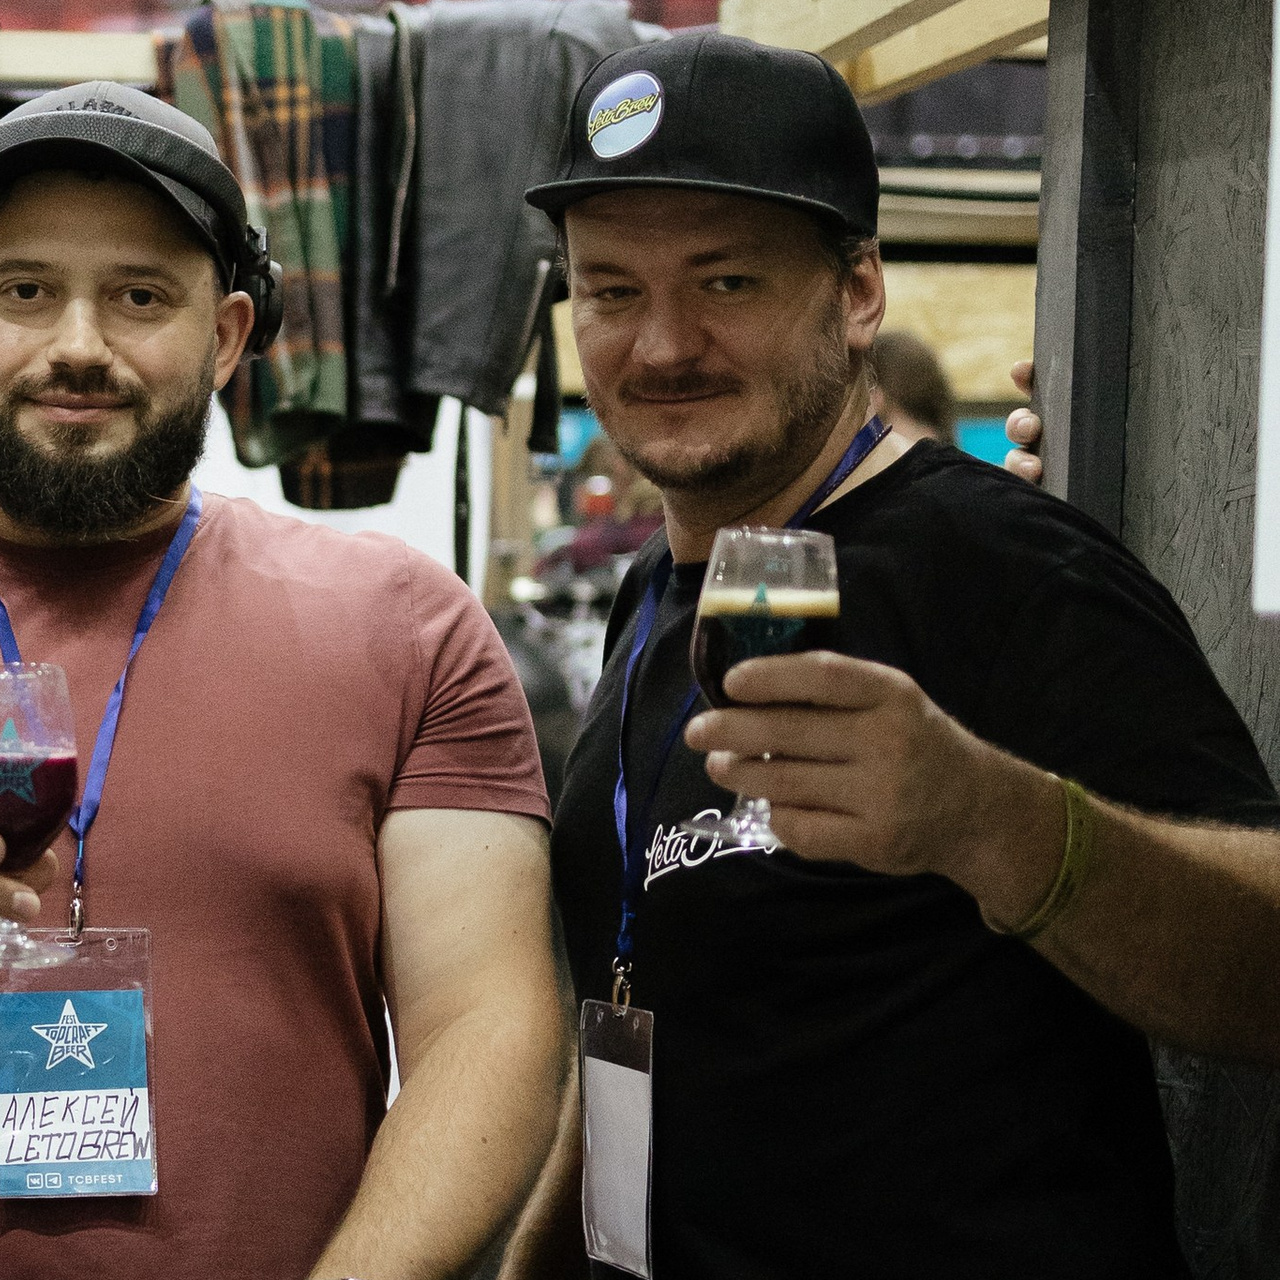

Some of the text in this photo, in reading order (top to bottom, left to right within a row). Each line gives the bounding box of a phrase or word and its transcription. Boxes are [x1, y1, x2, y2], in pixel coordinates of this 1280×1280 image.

[61, 1014, 77, 1025] FEST
[33, 1025, 105, 1045] TOPCRAFT
[48, 1044, 93, 1067] BEER
[1, 1087, 140, 1132] АЛЕКСЕЙ
[5, 1129, 150, 1164] LETOBREW
[67, 1174, 124, 1185] TCBFEST
